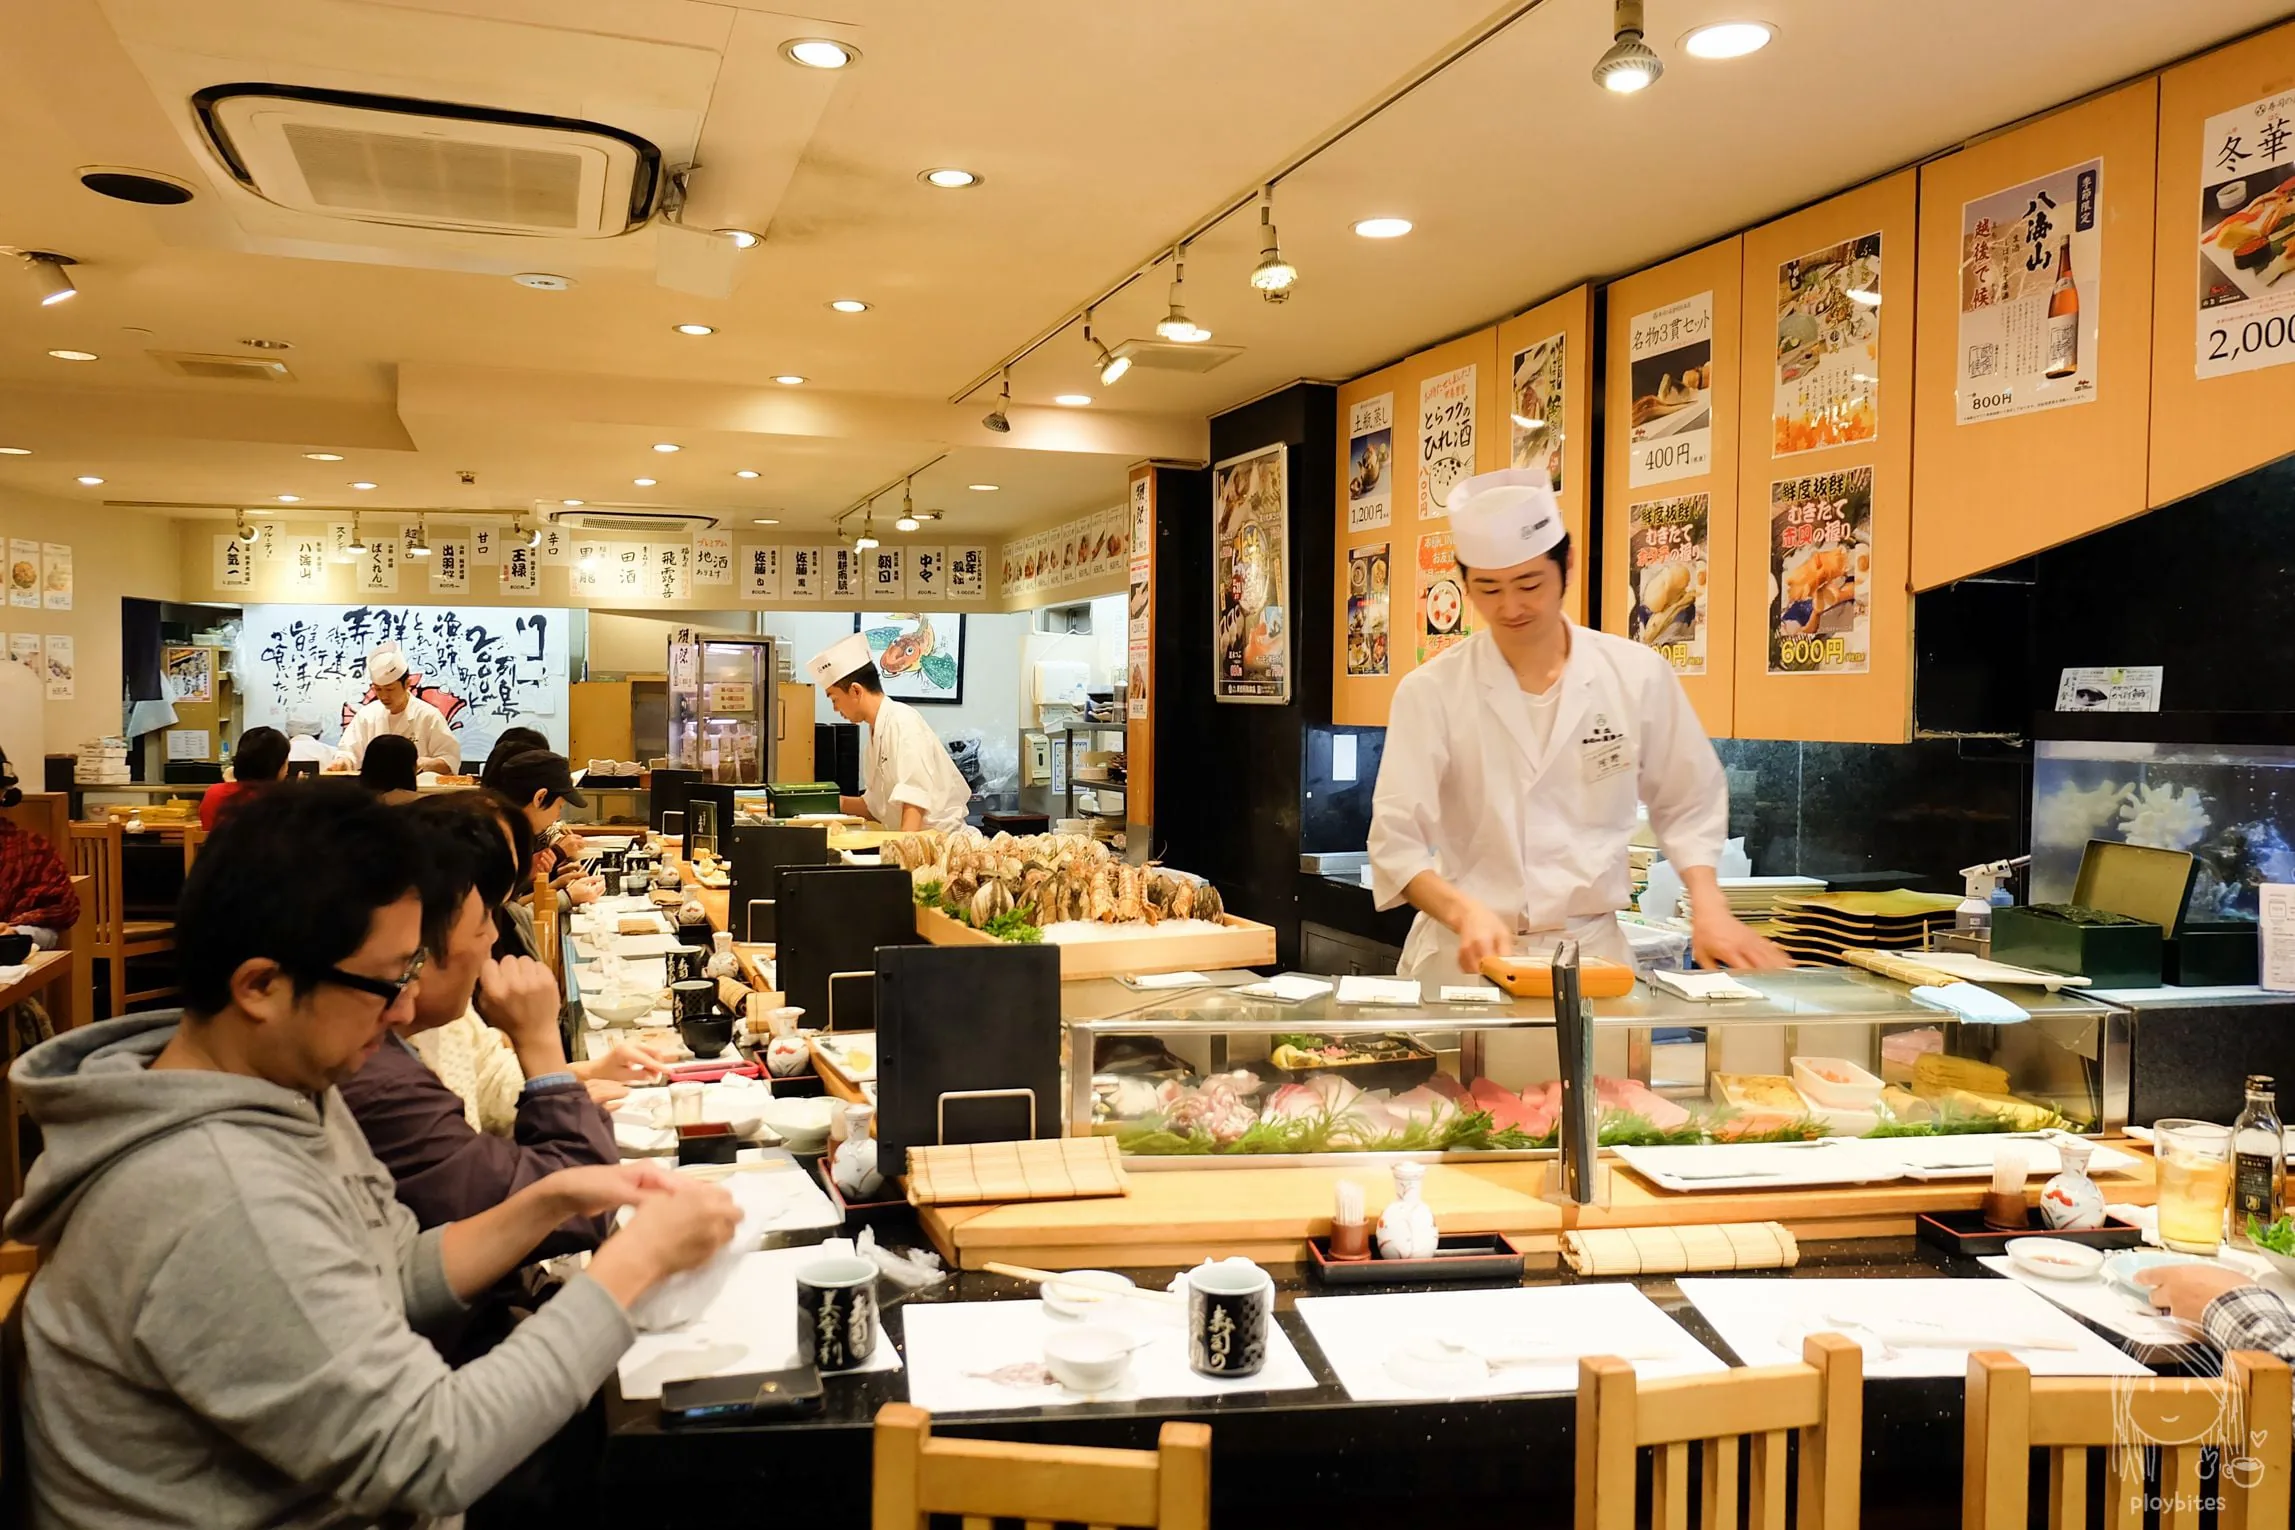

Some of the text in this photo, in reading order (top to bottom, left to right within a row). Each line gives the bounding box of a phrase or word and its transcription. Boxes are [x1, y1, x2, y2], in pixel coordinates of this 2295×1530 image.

[2216, 118, 2292, 172] 冬華
[2080, 176, 2092, 224] 季節限定
[2022, 191, 2056, 271] 八海山
[1972, 218, 1991, 309] 越後で候
[1632, 309, 1710, 351] 名物3貫セット
[1425, 396, 1470, 430] とらフグの
[1972, 393, 2012, 410] 800円
[1353, 407, 1387, 433] 土瓶蒸し
[1424, 419, 1472, 460] ひれ酒
[1645, 443, 1689, 470] 400円
[1352, 503, 1382, 524] 1,200円
[1788, 499, 1848, 524] むきたて
[477, 532, 489, 554] 甘口
[547, 532, 559, 555] 辛口
[697, 539, 728, 548] プレミアム
[1646, 524, 1693, 545] むきたて
[1782, 520, 1850, 547] 赤貝の握り
[227, 541, 240, 575] 人気一
[299, 542, 312, 579] 八海山
[371, 543, 383, 583] ばくれん
[511, 549, 527, 578] 王禄
[620, 551, 636, 584] 田酒
[698, 551, 728, 569] 地酒
[754, 551, 766, 575] 佐藤
[795, 551, 807, 575] 佐藤
[878, 554, 892, 583] 朝日
[919, 554, 933, 582] 中々
[1637, 543, 1700, 567] ホタテの握り
[661, 551, 677, 598] 飛露喜
[696, 568, 721, 579] あります
[1782, 638, 1844, 664] 600円
[1208, 1303, 1236, 1370] 寿司の
